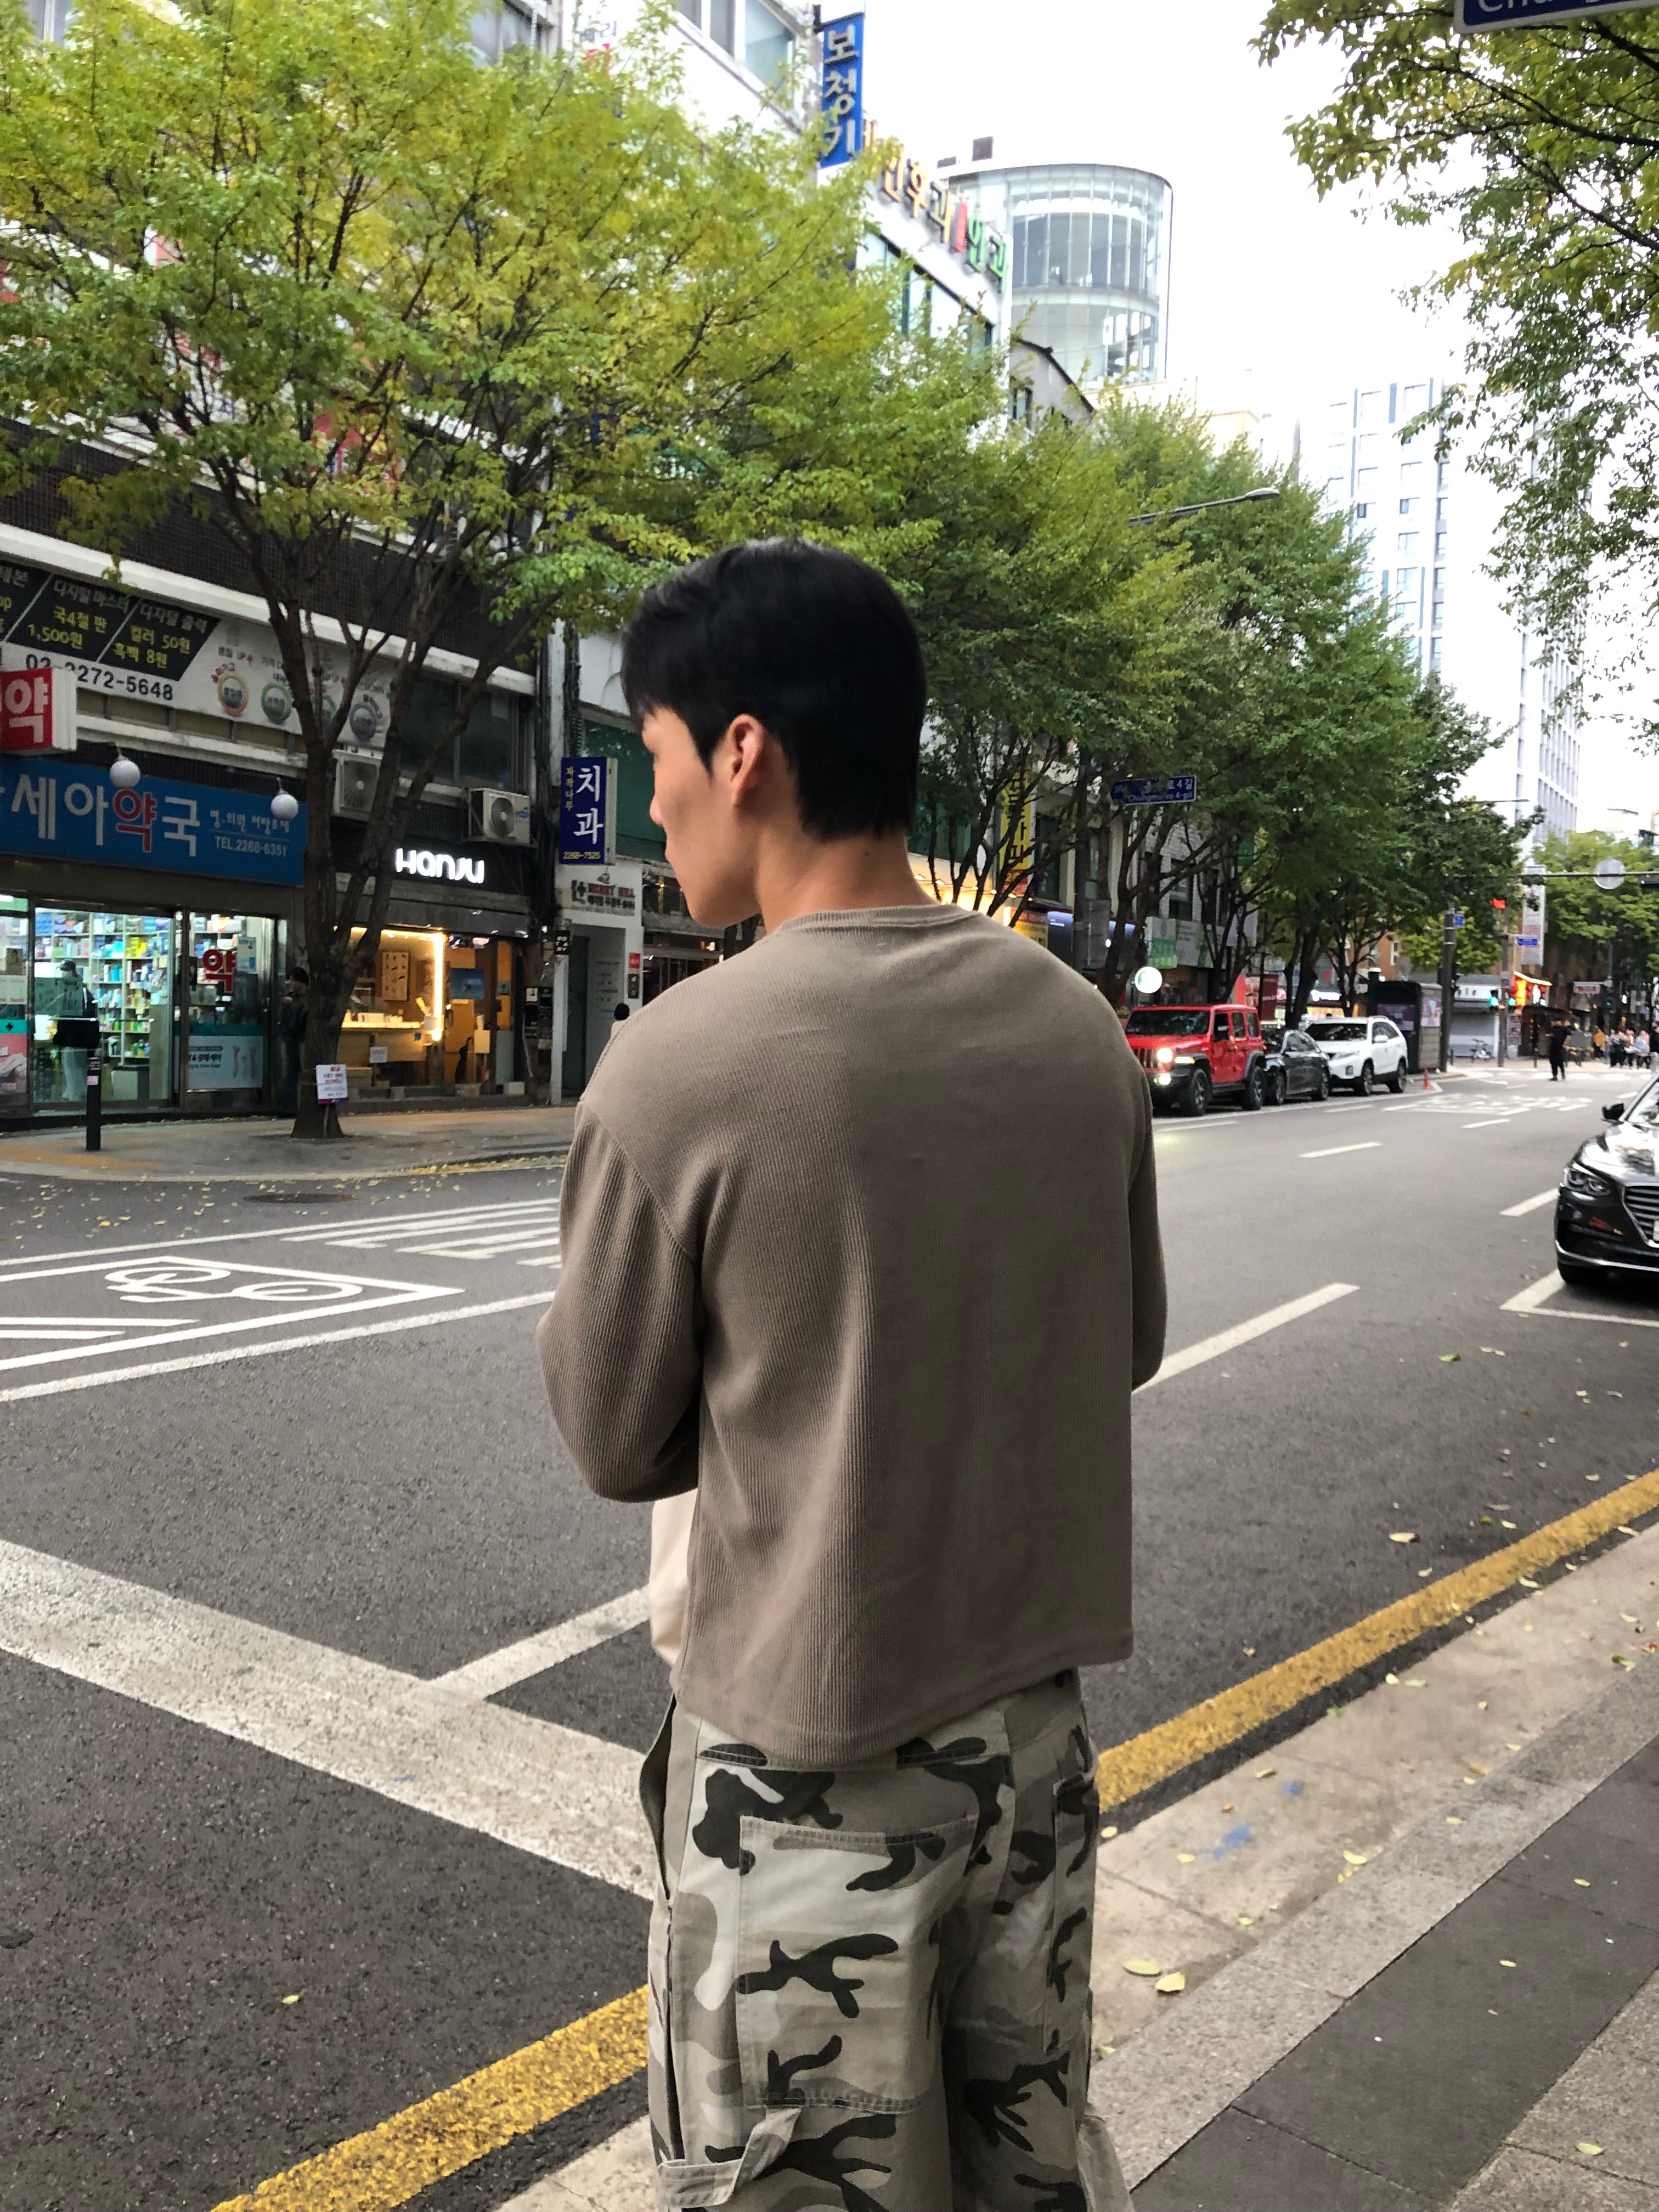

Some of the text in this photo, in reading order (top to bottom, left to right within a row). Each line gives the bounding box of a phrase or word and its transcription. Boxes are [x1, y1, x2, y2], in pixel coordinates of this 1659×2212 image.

[823, 24, 859, 157] 보청기
[966, 216, 1008, 294] 안과
[131, 626, 190, 654] 컬러 50원
[140, 604, 180, 627] 디지털
[0, 774, 200, 857] 세아약국
[573, 765, 603, 844] 치과
[202, 949, 236, 993] 약
